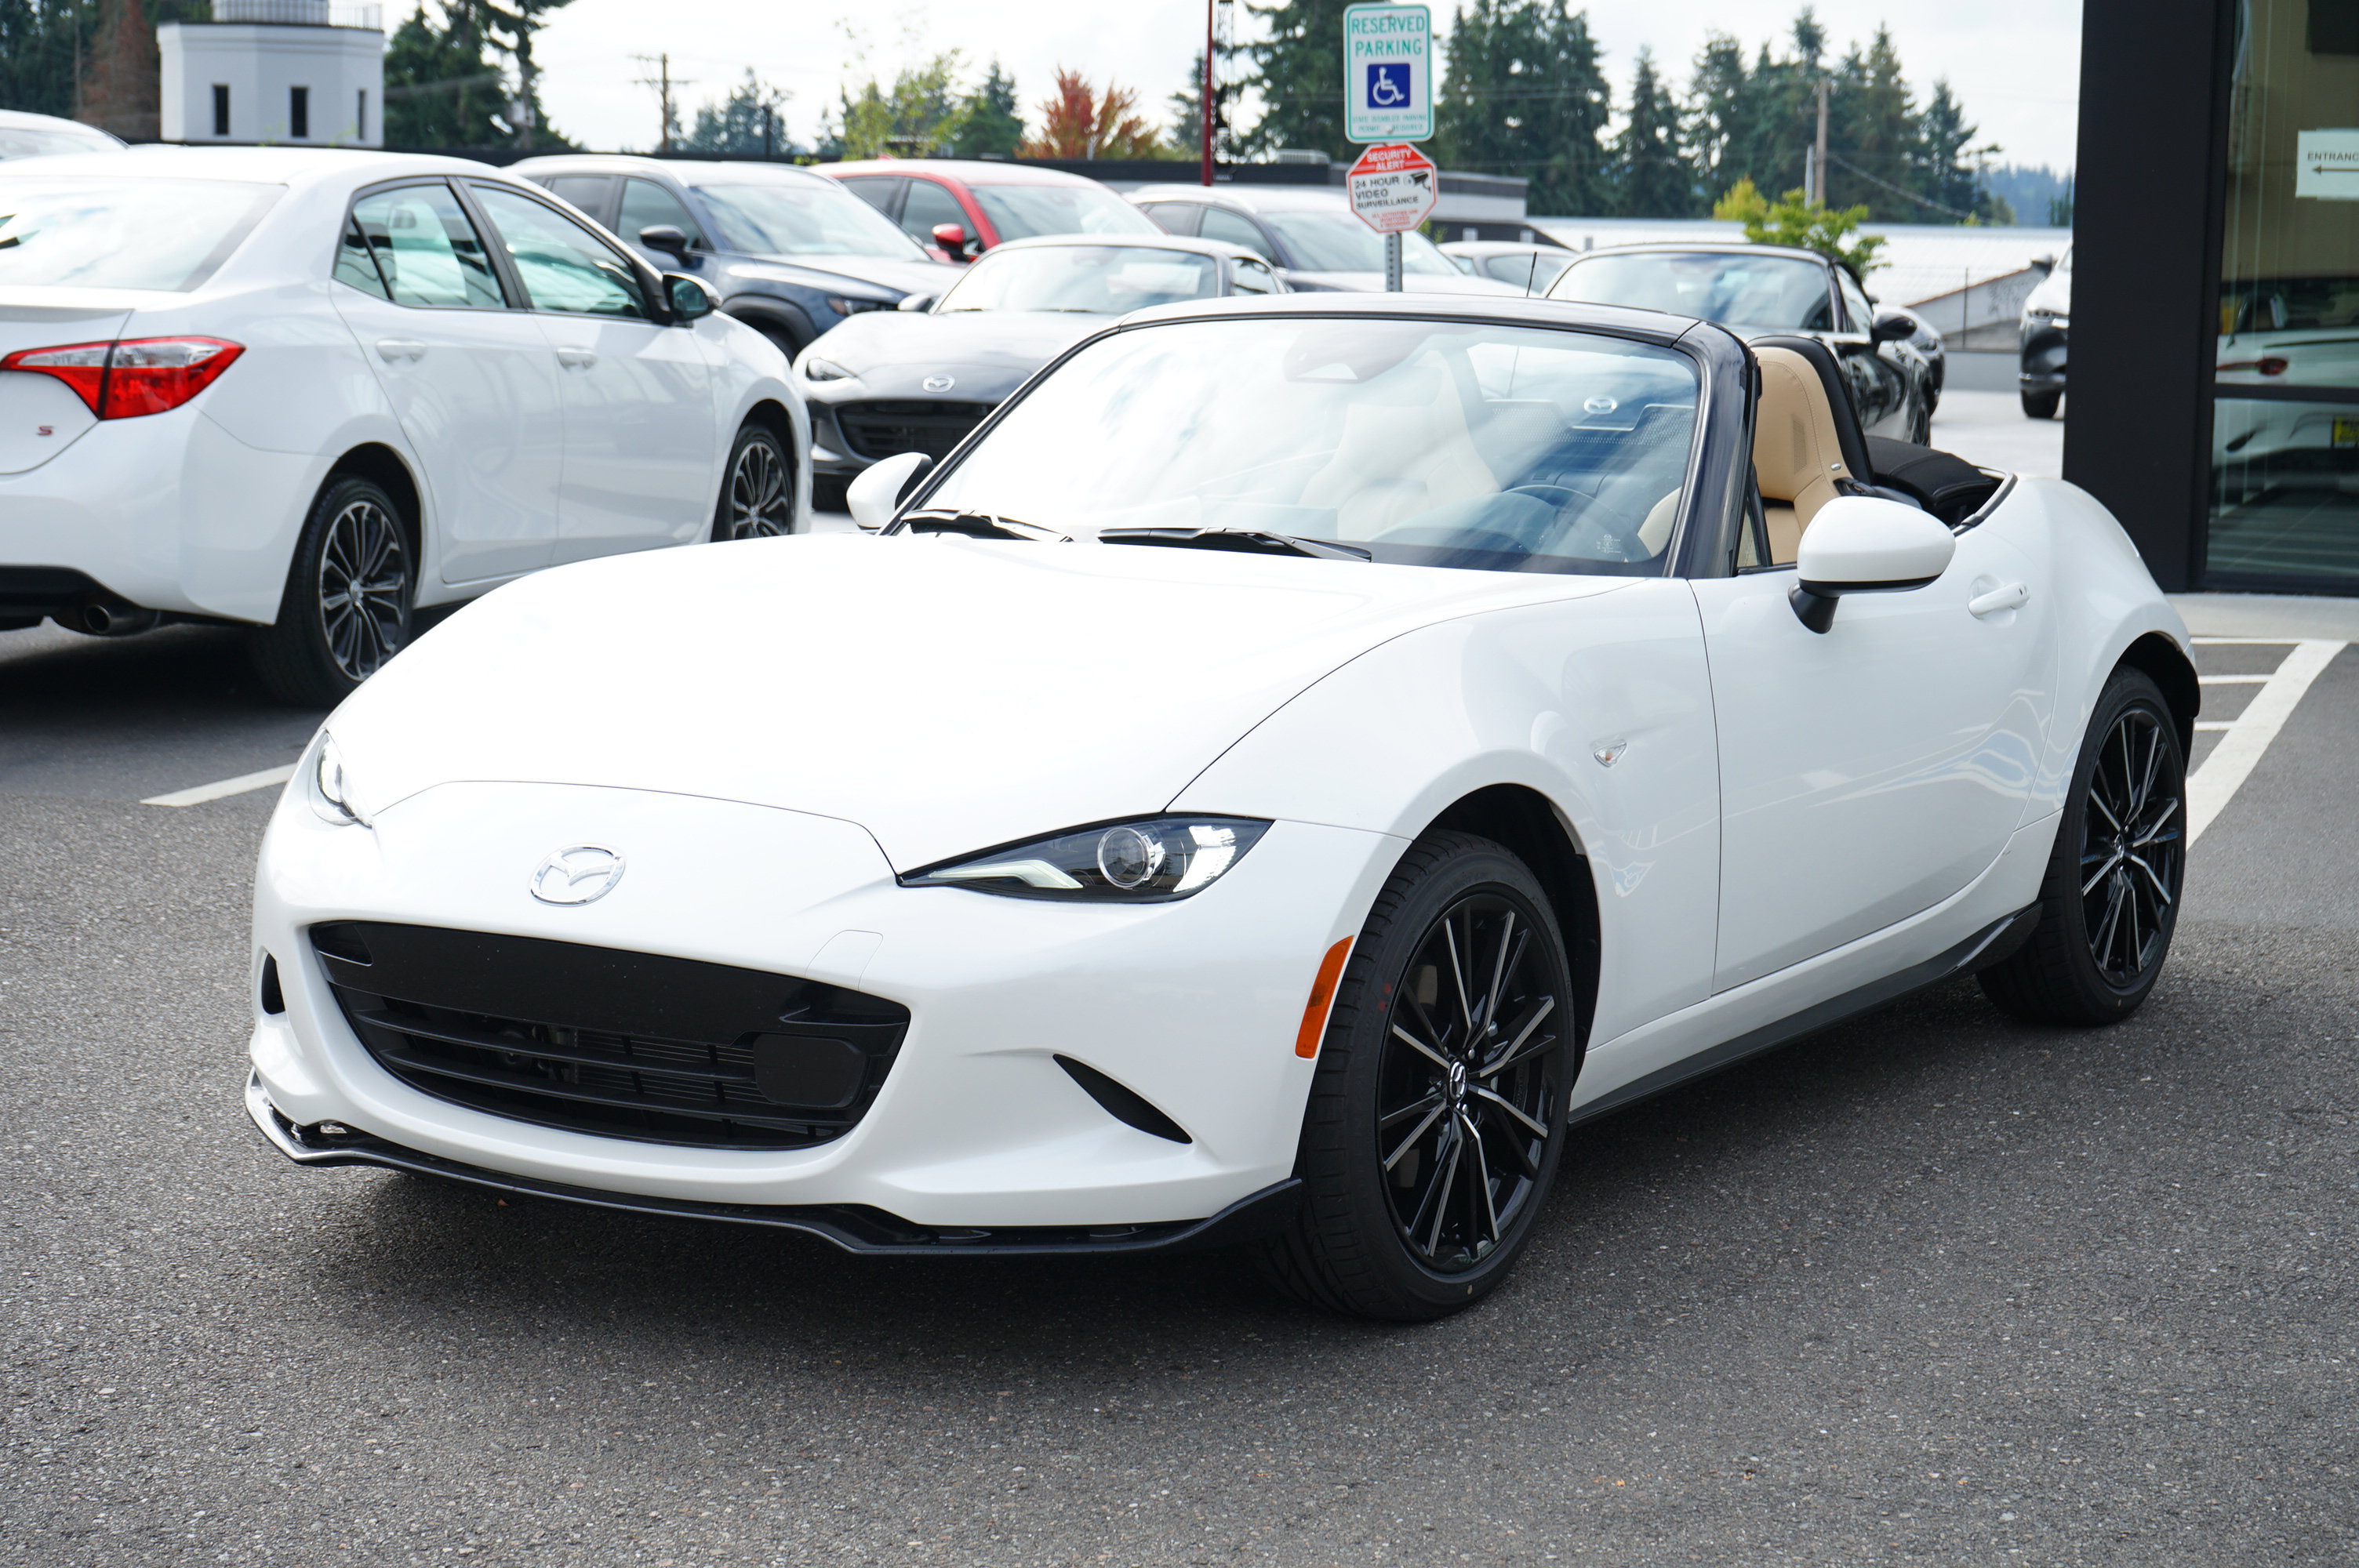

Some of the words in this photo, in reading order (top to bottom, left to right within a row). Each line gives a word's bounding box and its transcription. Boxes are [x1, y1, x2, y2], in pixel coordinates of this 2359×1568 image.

[1351, 16, 1425, 34] RESERVED
[1355, 38, 1422, 57] PARKING
[1367, 148, 1412, 162] SECURITY
[1376, 160, 1405, 172] ALERT
[1355, 180, 1367, 189] 24
[1370, 176, 1399, 188] HOUR
[1355, 188, 1389, 200] VIDEO
[1356, 196, 1419, 210] SURVEILLANCE
